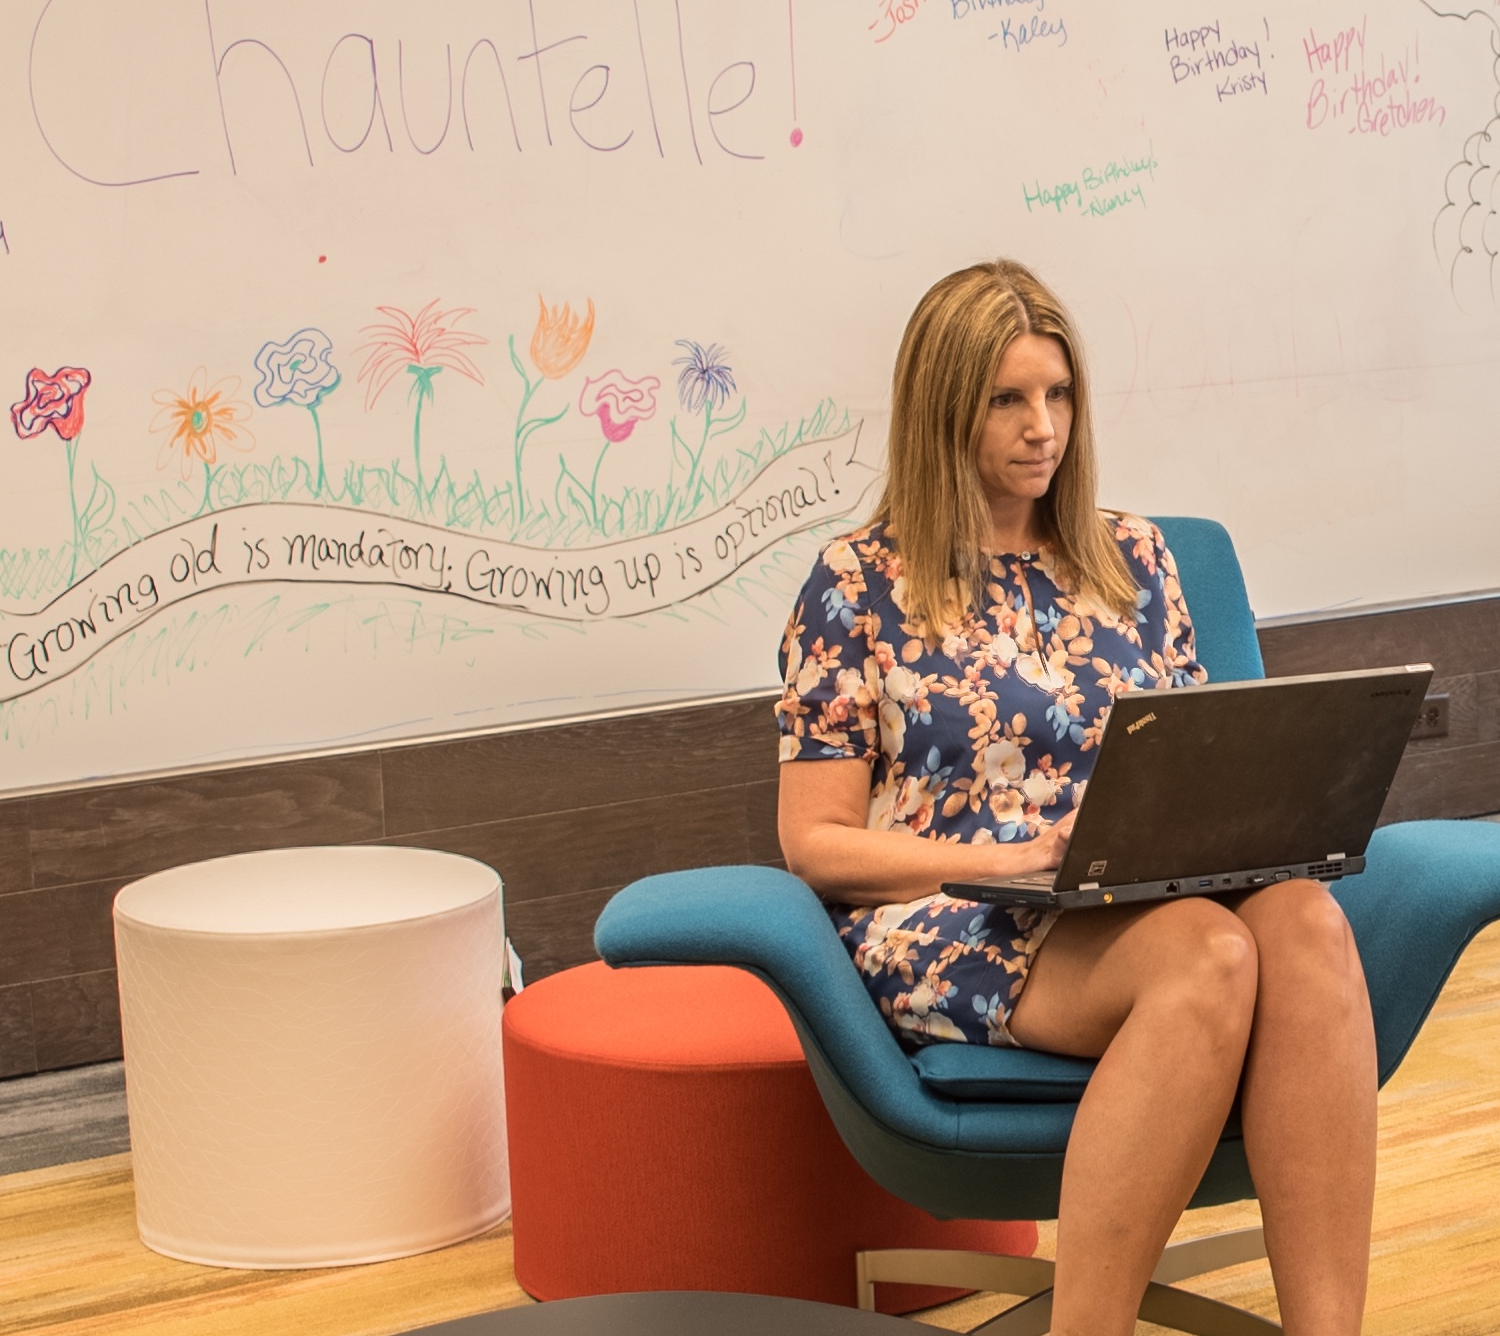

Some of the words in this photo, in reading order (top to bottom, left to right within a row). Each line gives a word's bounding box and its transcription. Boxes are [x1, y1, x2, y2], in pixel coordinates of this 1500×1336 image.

[1165, 20, 1221, 51] Happy
[1170, 17, 1274, 84] Birthday!
[1303, 14, 1367, 73] Happy
[1217, 72, 1268, 102] Kristy
[1306, 29, 1420, 130] Birthday!
[1022, 180, 1082, 214] Happy
[6, 571, 158, 681] Growing
[168, 525, 224, 581] old
[240, 525, 272, 575] is
[465, 550, 612, 617] Growing
[618, 549, 663, 609] up
[673, 535, 705, 581] is
[712, 449, 845, 568] optional!
